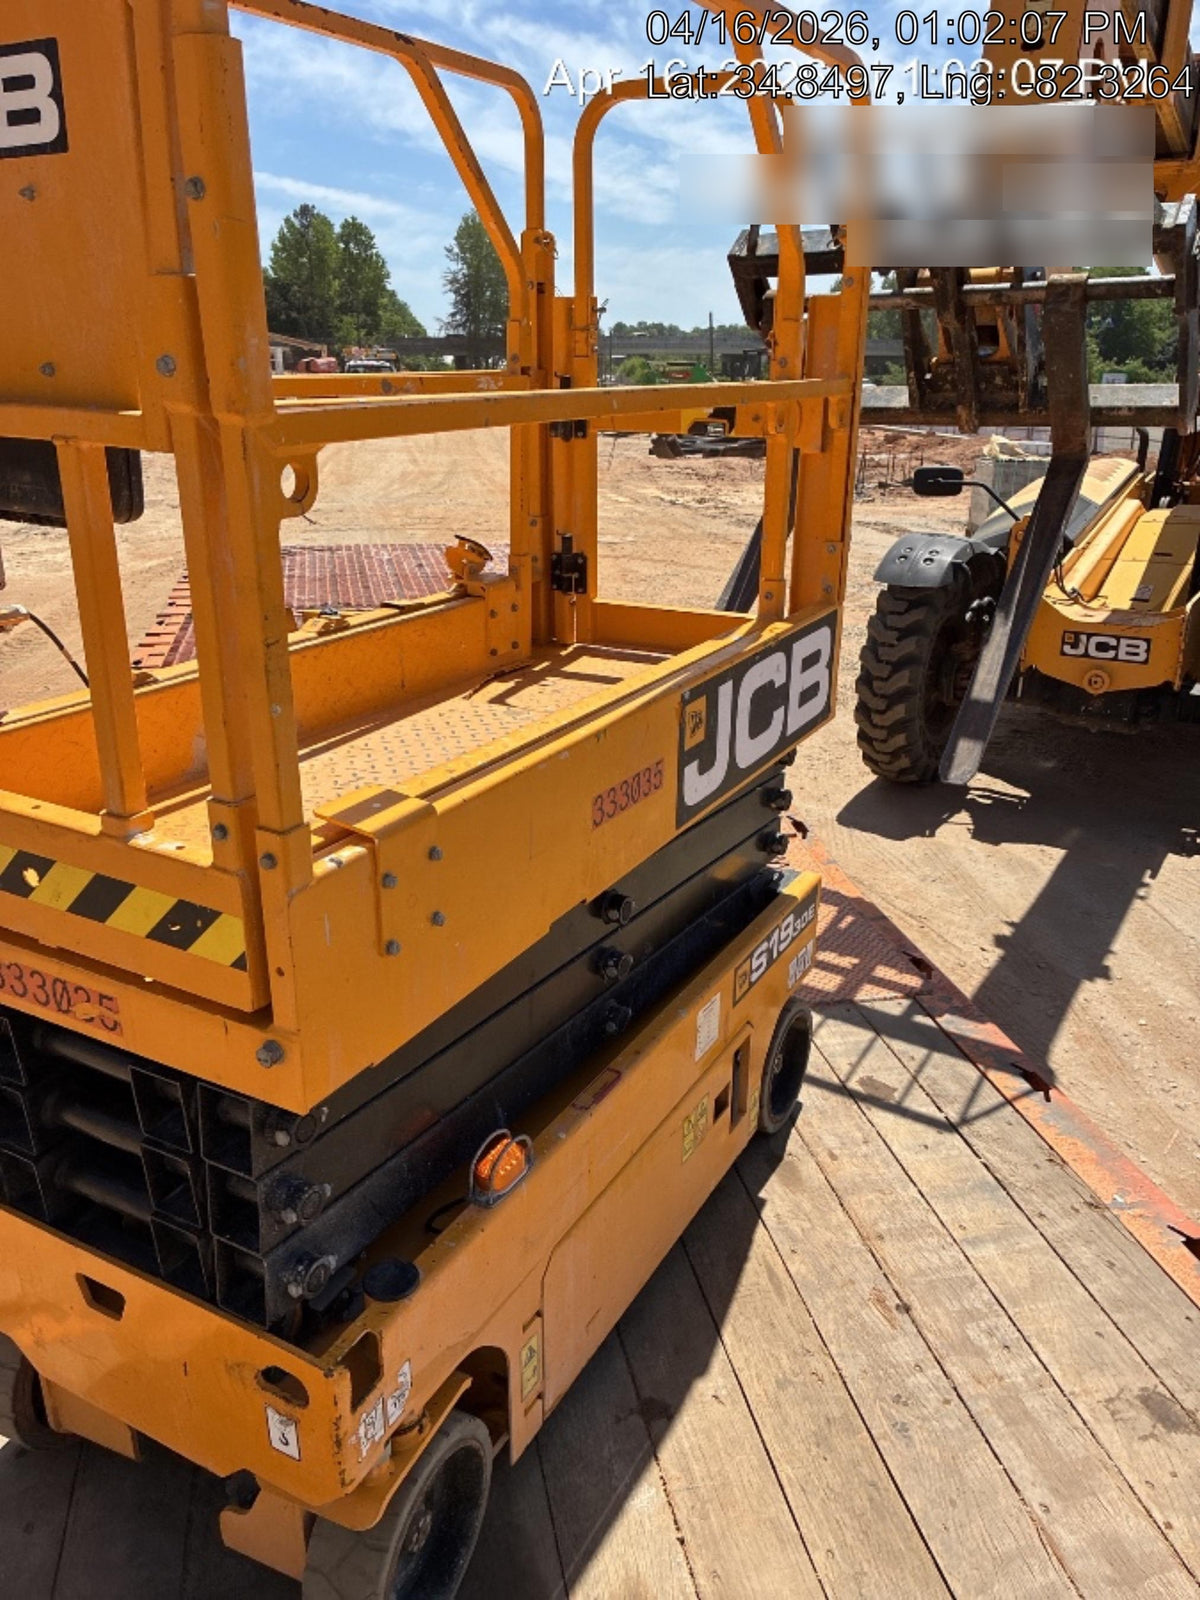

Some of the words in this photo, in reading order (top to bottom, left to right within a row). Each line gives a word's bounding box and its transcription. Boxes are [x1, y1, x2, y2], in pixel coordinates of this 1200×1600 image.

[1063, 633, 1148, 662] JCB
[683, 625, 831, 806] JCB
[593, 758, 664, 828] 333035
